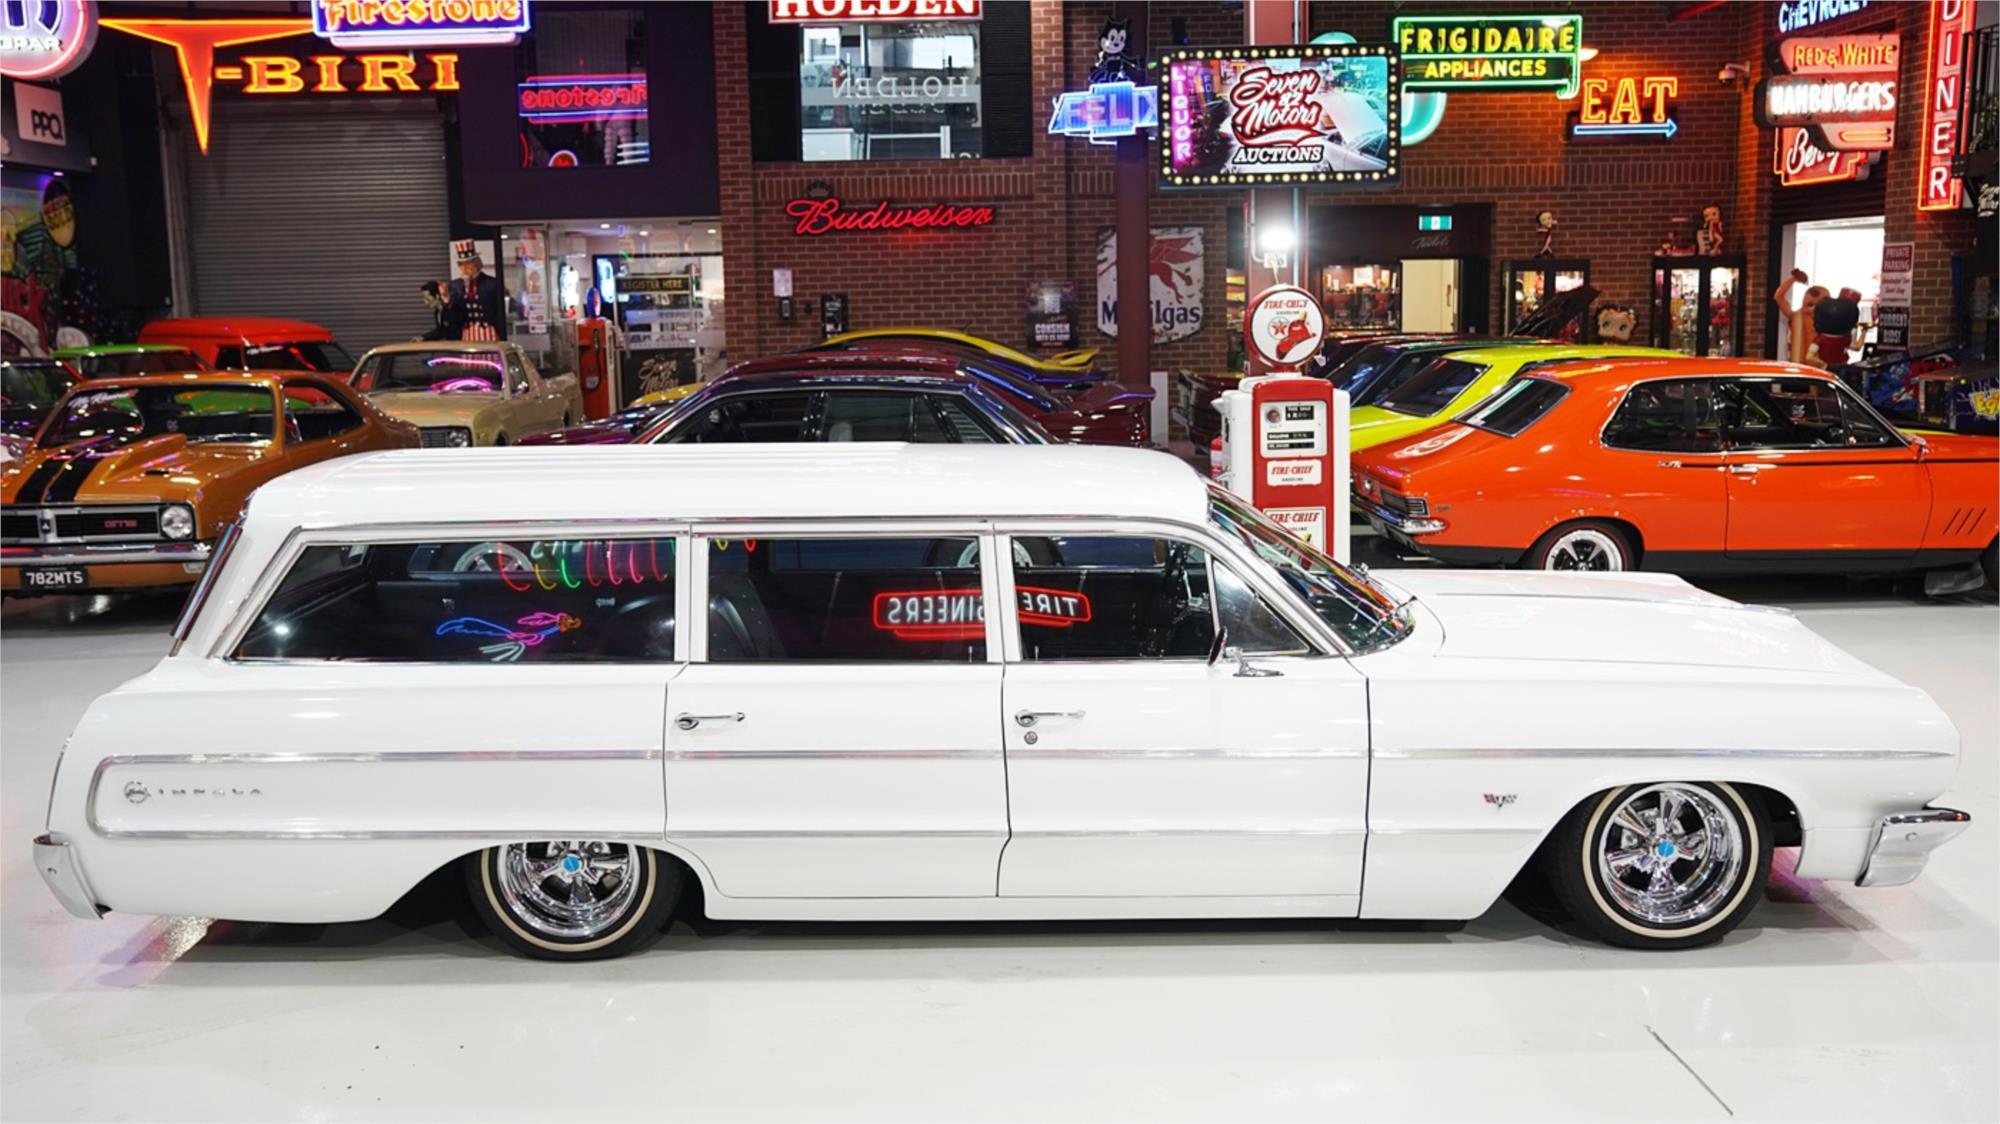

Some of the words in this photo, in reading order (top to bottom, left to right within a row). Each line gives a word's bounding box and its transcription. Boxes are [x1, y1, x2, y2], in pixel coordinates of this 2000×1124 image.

[324, 0, 521, 31] Firestone
[775, 0, 975, 17] HOLDEN
[0, 36, 63, 51] OPAR
[1401, 26, 1574, 53] FRIGIDAIRE
[1795, 46, 1822, 66] RED
[1842, 43, 1894, 65] WHITE
[1424, 60, 1546, 79] APPLIANCES
[1232, 70, 1315, 106] Seven
[1581, 77, 1677, 124] EAT
[1769, 81, 1895, 115] HAMBURGERS
[1929, 0, 1961, 199] DINER
[1171, 66, 1191, 162] LIQUOR
[1235, 100, 1318, 136] Motors
[1234, 146, 1322, 163] AUCTIONS
[785, 198, 993, 235] Budweiser
